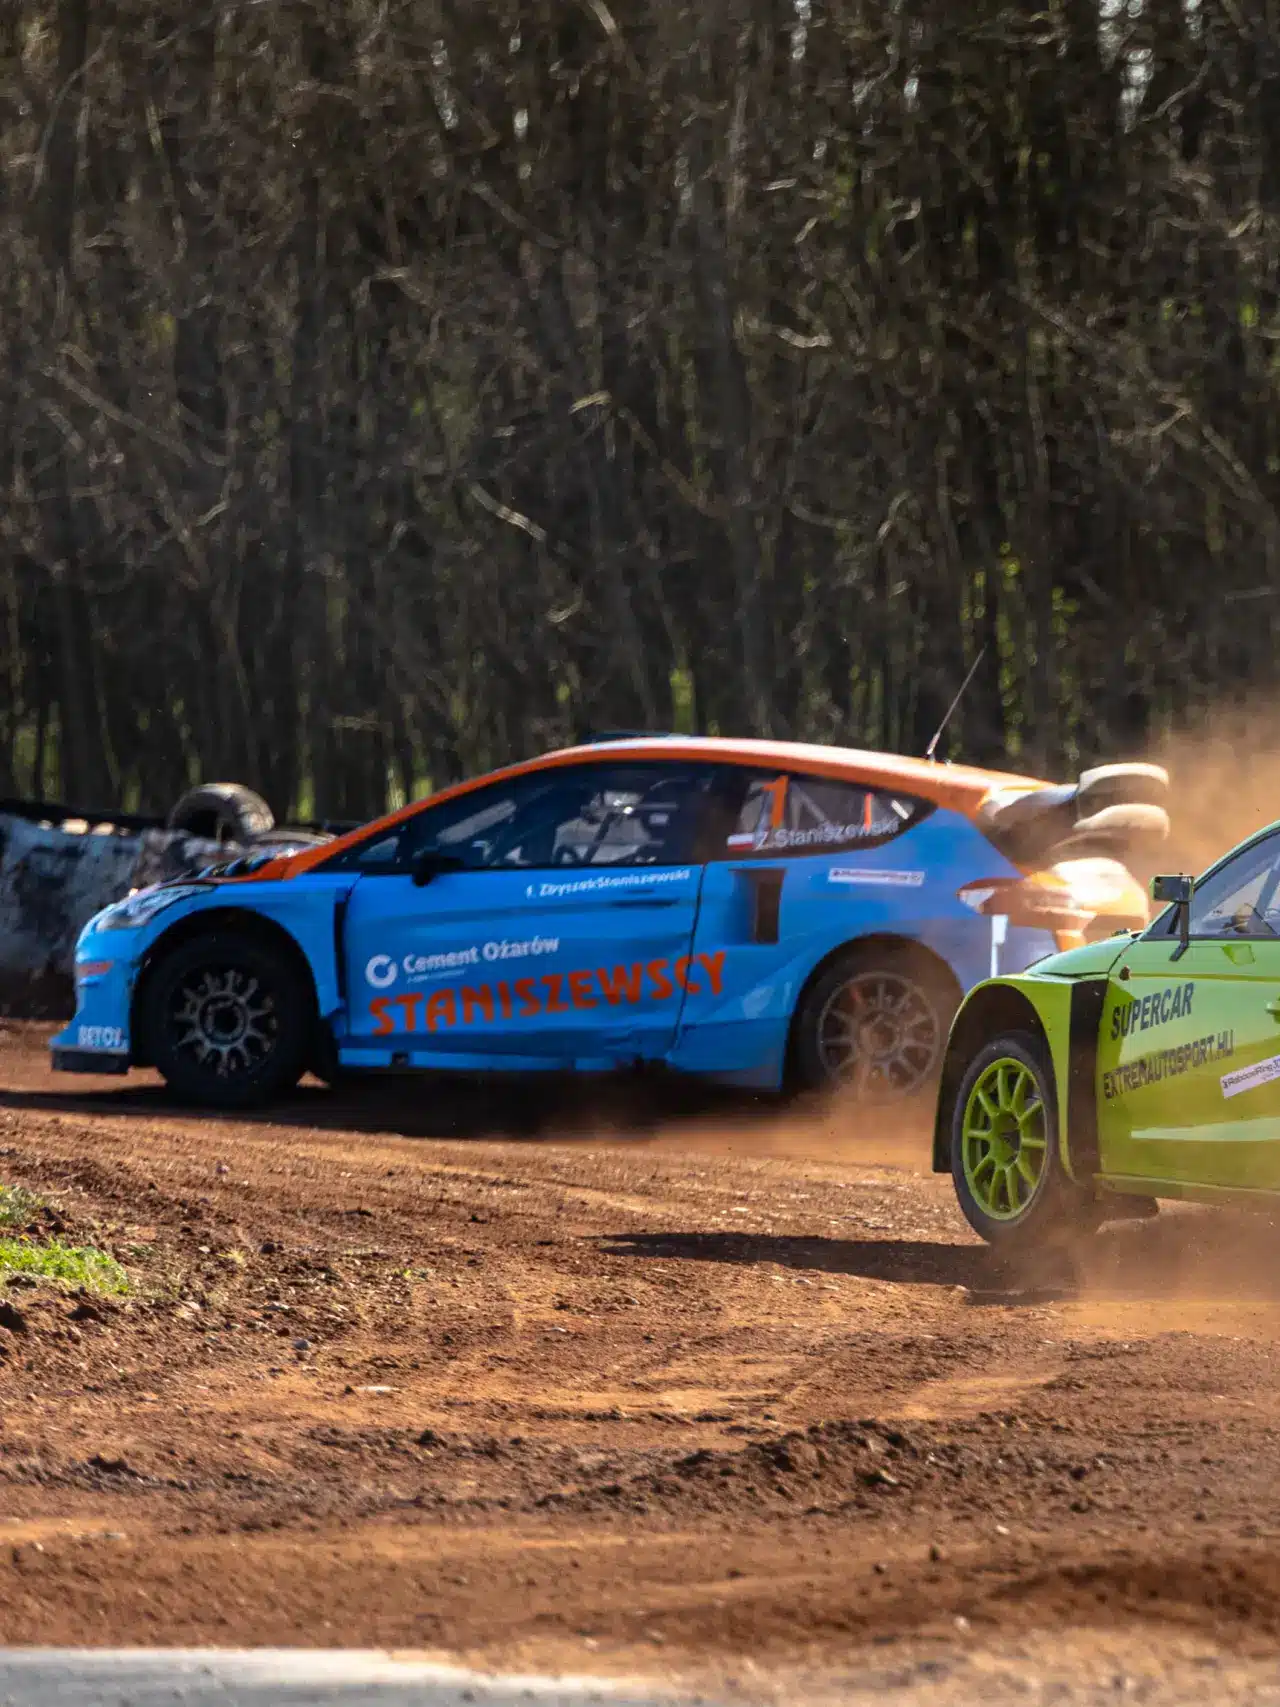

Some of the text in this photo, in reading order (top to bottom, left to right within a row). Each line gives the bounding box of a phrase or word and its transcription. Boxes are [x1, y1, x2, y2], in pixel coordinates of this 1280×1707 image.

[403, 936, 559, 973] Cement Ożarów
[369, 951, 727, 1036] STANISZEWSCY
[1111, 982, 1194, 1040] SUPERCAR
[1103, 1029, 1234, 1099] EXTREMAUTOSPORT.HU
